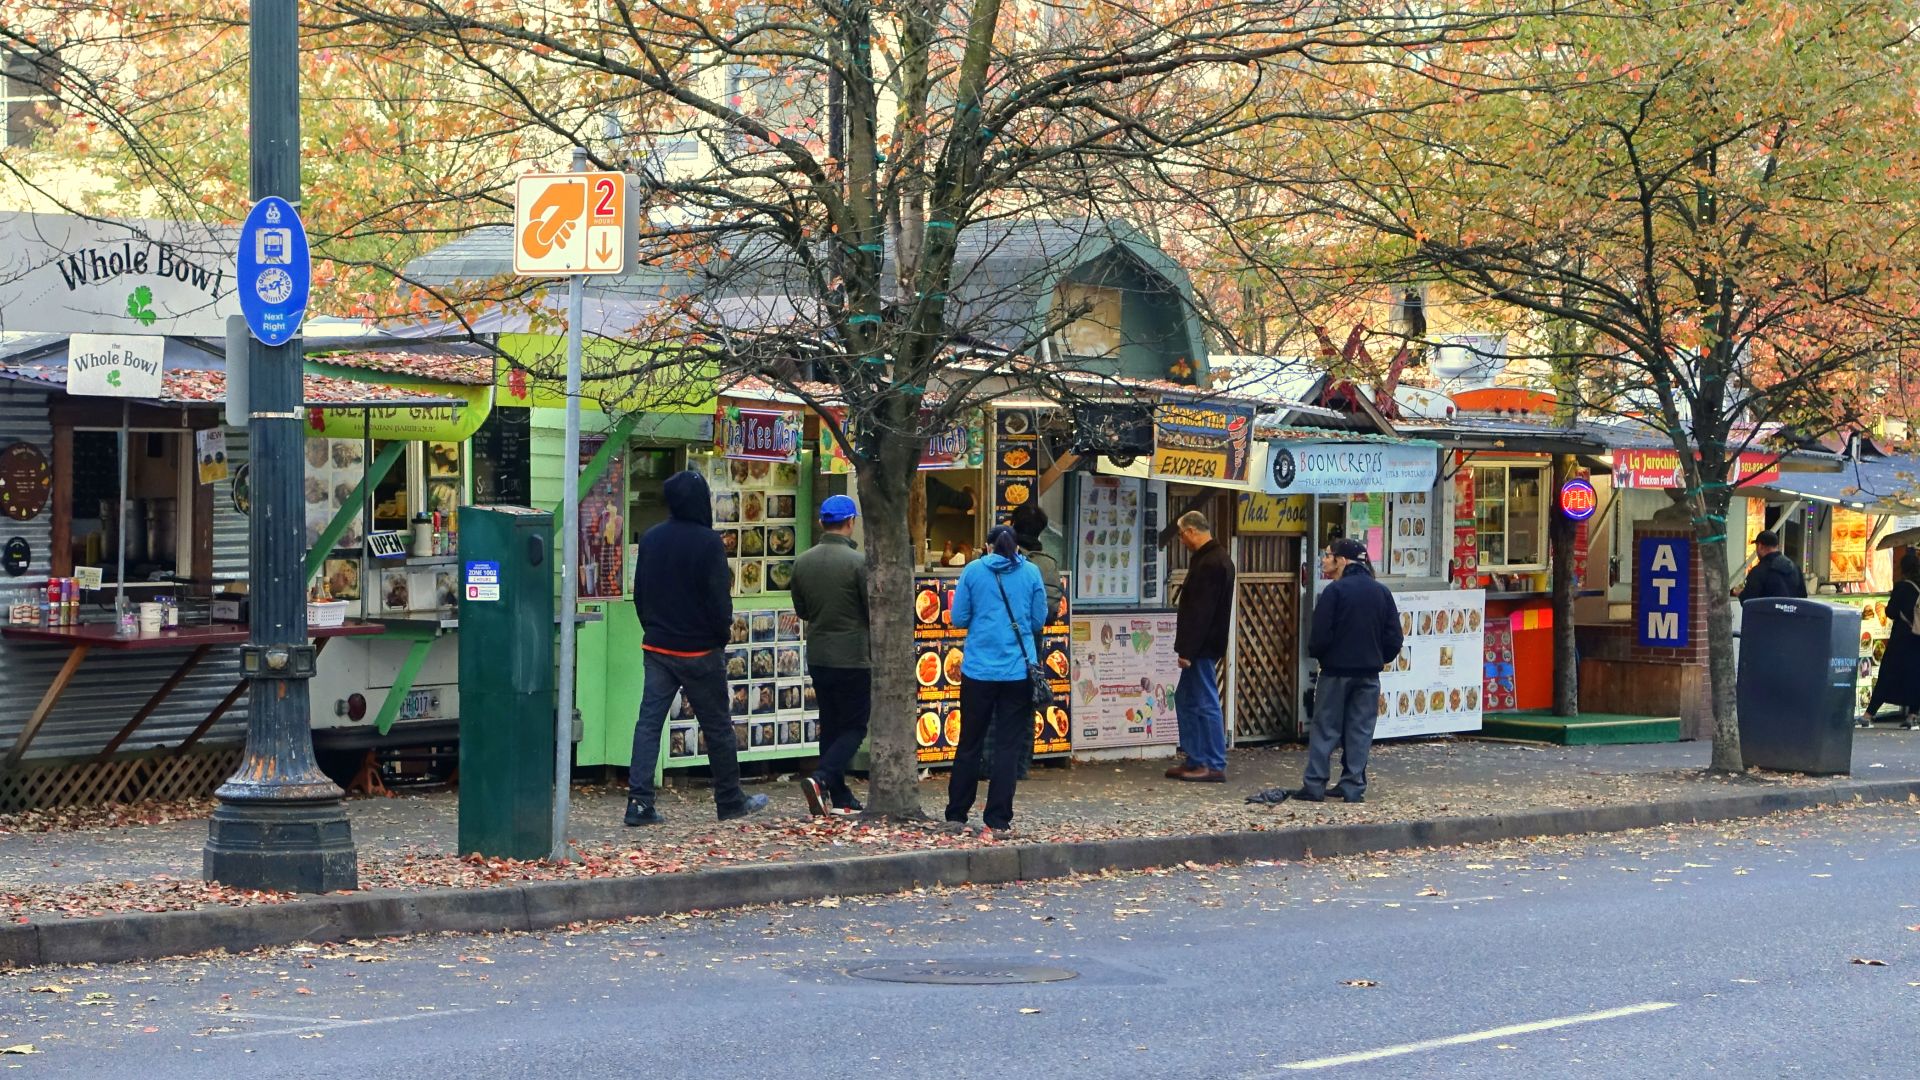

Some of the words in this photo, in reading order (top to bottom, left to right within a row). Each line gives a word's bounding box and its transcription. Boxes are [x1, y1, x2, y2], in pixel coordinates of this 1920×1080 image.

[595, 178, 615, 217] 2
[56, 243, 149, 291] Whole
[157, 243, 223, 298] Bowl
[258, 269, 278, 286] QUICK
[263, 322, 285, 332] Right
[264, 313, 283, 321] Next
[74, 350, 120, 373] Whole
[123, 350, 158, 376] Bowl
[354, 424, 393, 432] HAAIIAN
[749, 418, 771, 450] Kee
[773, 420, 798, 453] Man
[1160, 456, 1217, 478] EXPRESS
[1300, 452, 1382, 473] BOOMCREPES
[1629, 453, 1639, 470] La
[1639, 474, 1659, 485] Mexican
[1660, 474, 1673, 486] Food
[1238, 492, 1270, 525] Thai
[1276, 497, 1307, 528] Food
[1563, 490, 1593, 510] OPEN
[372, 533, 404, 555] OPEN
[1648, 544, 1679, 640] ATM
[414, 696, 428, 712] 017
